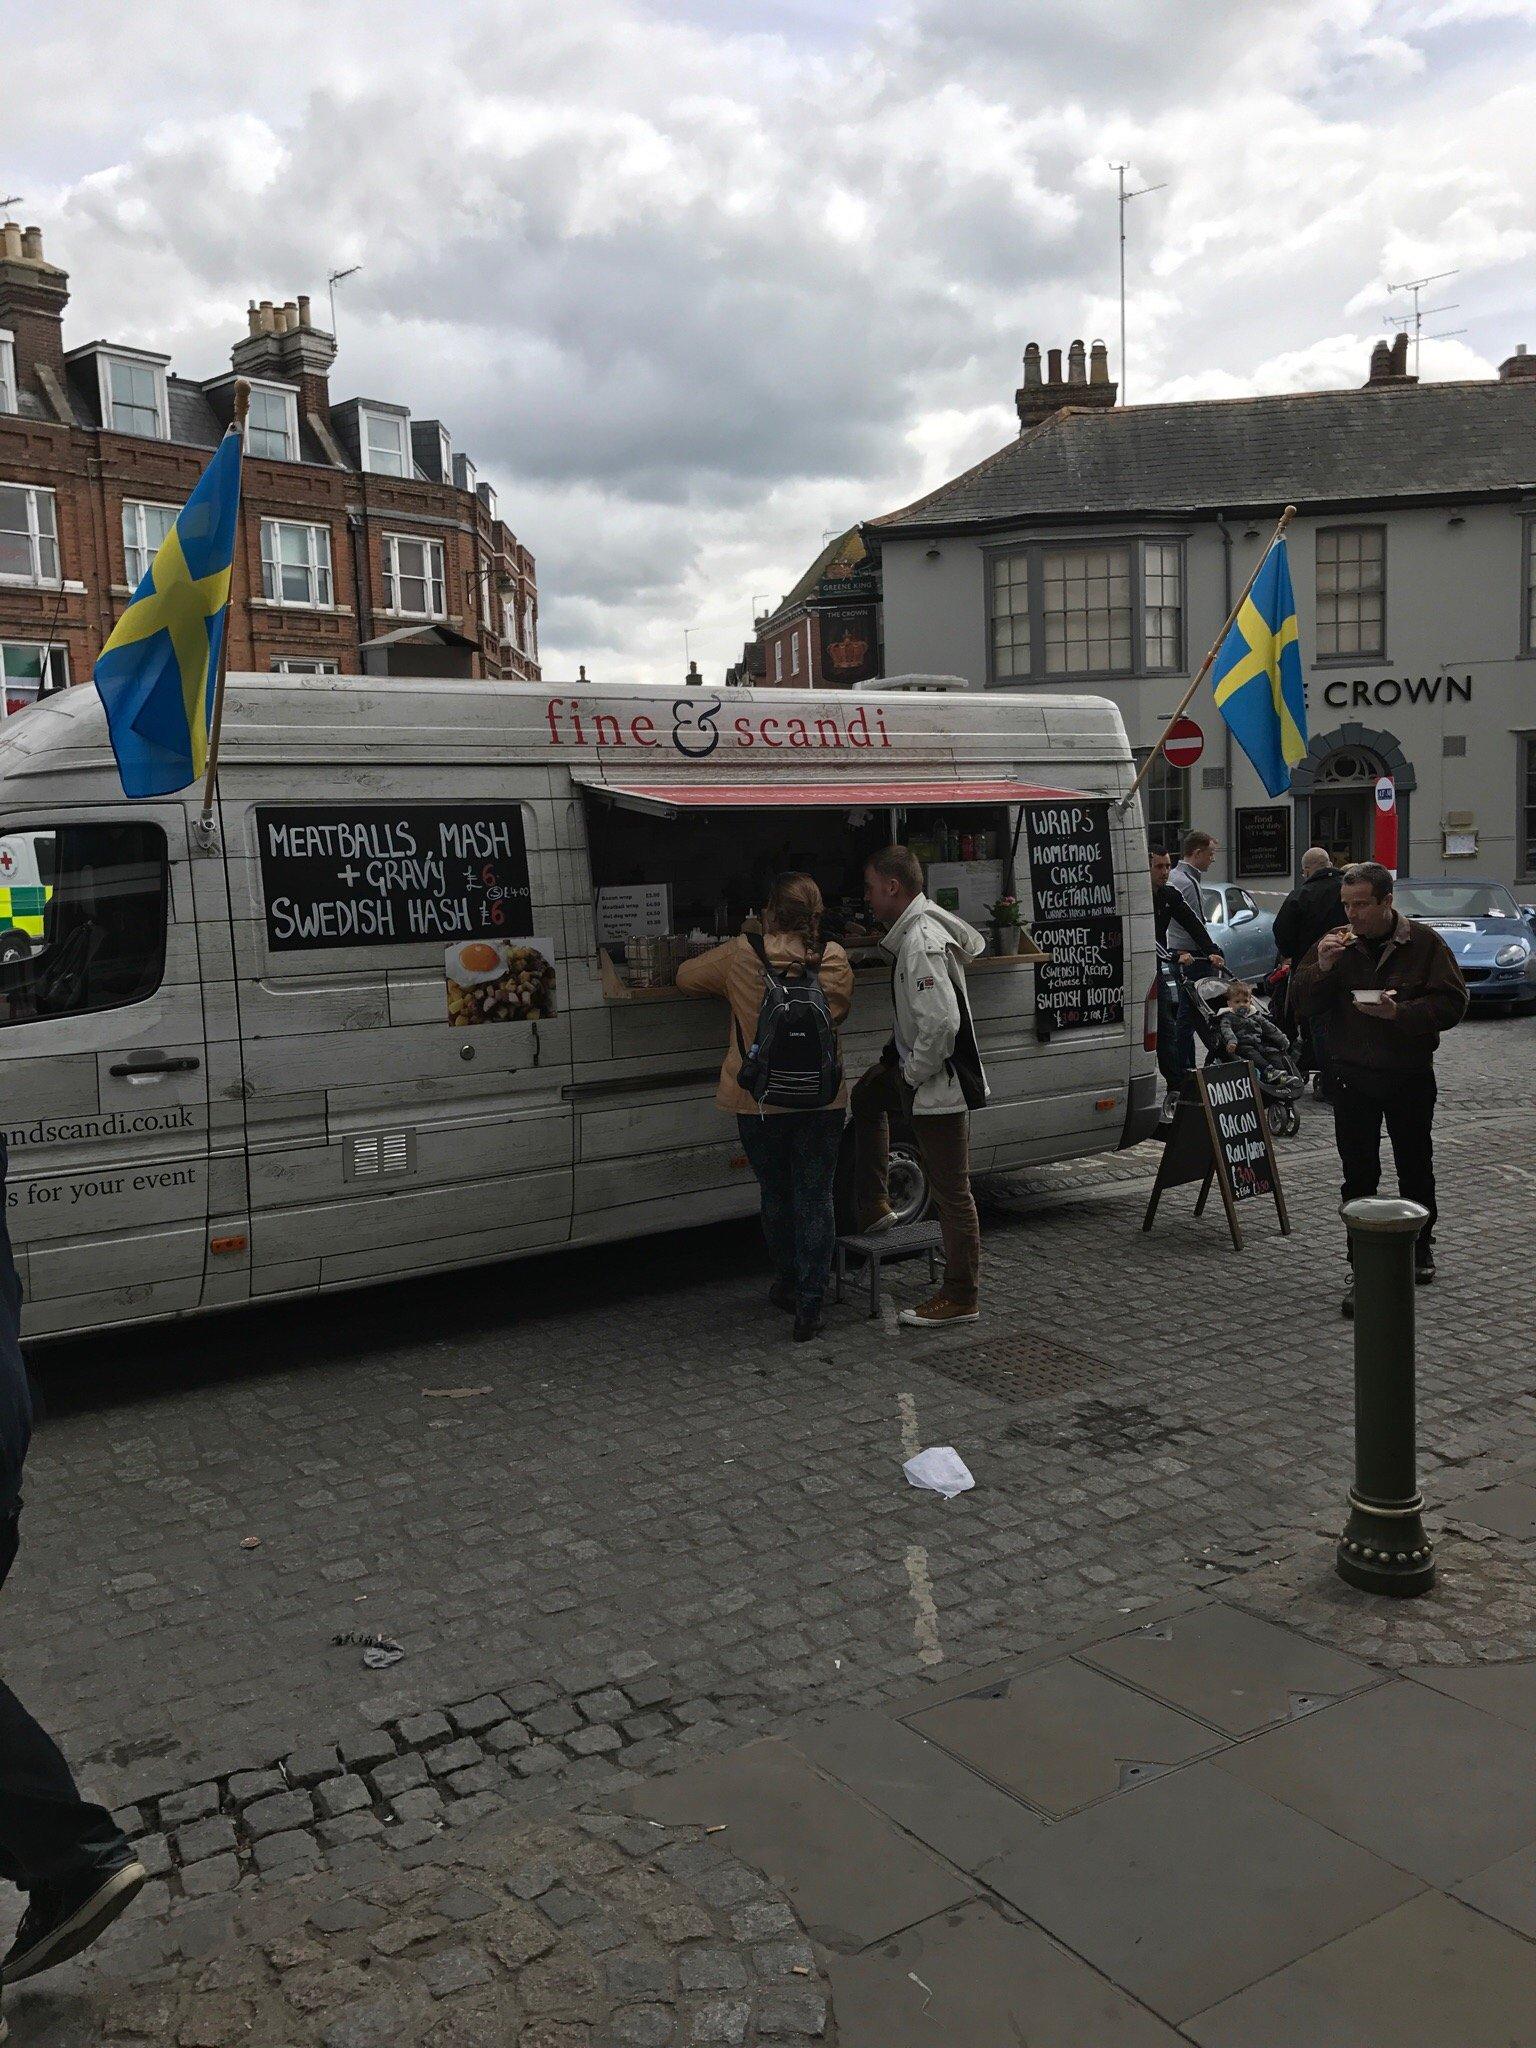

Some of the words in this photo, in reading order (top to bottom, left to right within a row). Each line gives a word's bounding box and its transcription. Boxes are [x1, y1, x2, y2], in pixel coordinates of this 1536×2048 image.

[822, 583, 852, 592] GREENE
[853, 581, 872, 589] KING
[841, 609, 869, 618] CROWN
[1323, 675, 1472, 707] CROWN
[545, 698, 658, 746] fine
[672, 695, 722, 758] &
[734, 706, 892, 748] scandi
[1031, 807, 1094, 834] WRAPS
[438, 821, 513, 858] MASH
[1033, 843, 1103, 865] HOMEMADE
[337, 864, 361, 887] +
[366, 860, 446, 897] GRAVY
[1051, 864, 1094, 885] CAKES
[1037, 884, 1113, 909] VEGETARIAN
[271, 897, 396, 938] SWEDISH
[408, 897, 473, 934] HASH
[480, 898, 507, 926] £6
[1034, 927, 1091, 950] GOURMET
[1053, 945, 1106, 967] BURGER
[1037, 990, 1081, 1010] SWEDISH
[1083, 1011, 1088, 1022] 2
[1089, 1009, 1102, 1020] FOR
[1207, 1077, 1254, 1107] DANISH
[1219, 1110, 1258, 1139] BACON
[28, 1183, 63, 1205] for
[69, 1177, 125, 1204] your
[133, 1168, 196, 1191] event
